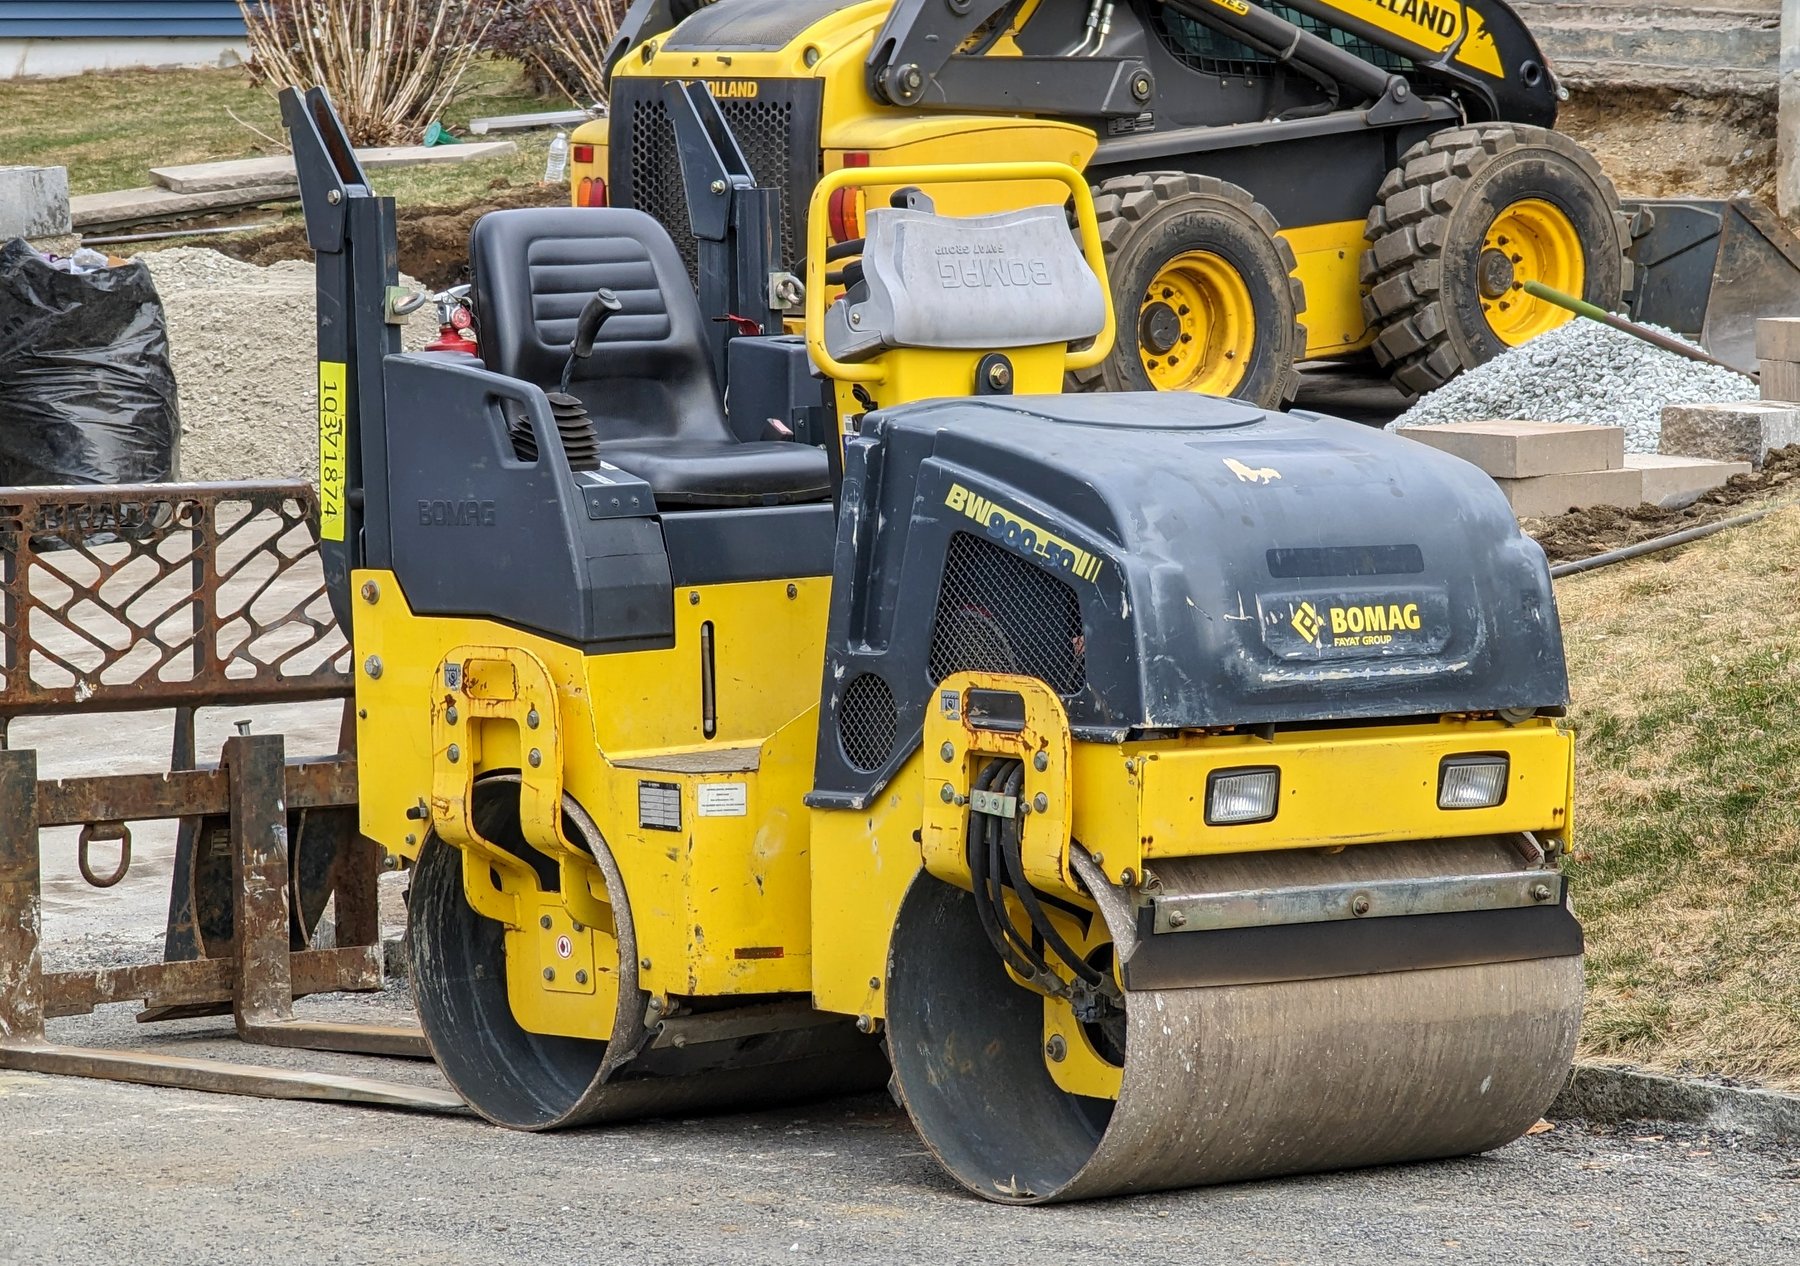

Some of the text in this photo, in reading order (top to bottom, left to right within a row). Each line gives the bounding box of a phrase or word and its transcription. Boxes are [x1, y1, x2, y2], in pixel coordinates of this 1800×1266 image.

[706, 81, 758, 98] OLLAND
[937, 259, 1053, 289] BOMAG
[322, 381, 338, 517] 10371874
[417, 499, 496, 526] BOMAG
[1330, 603, 1421, 634] BOMAG
[1334, 635, 1392, 647] FAYAT GROUP
